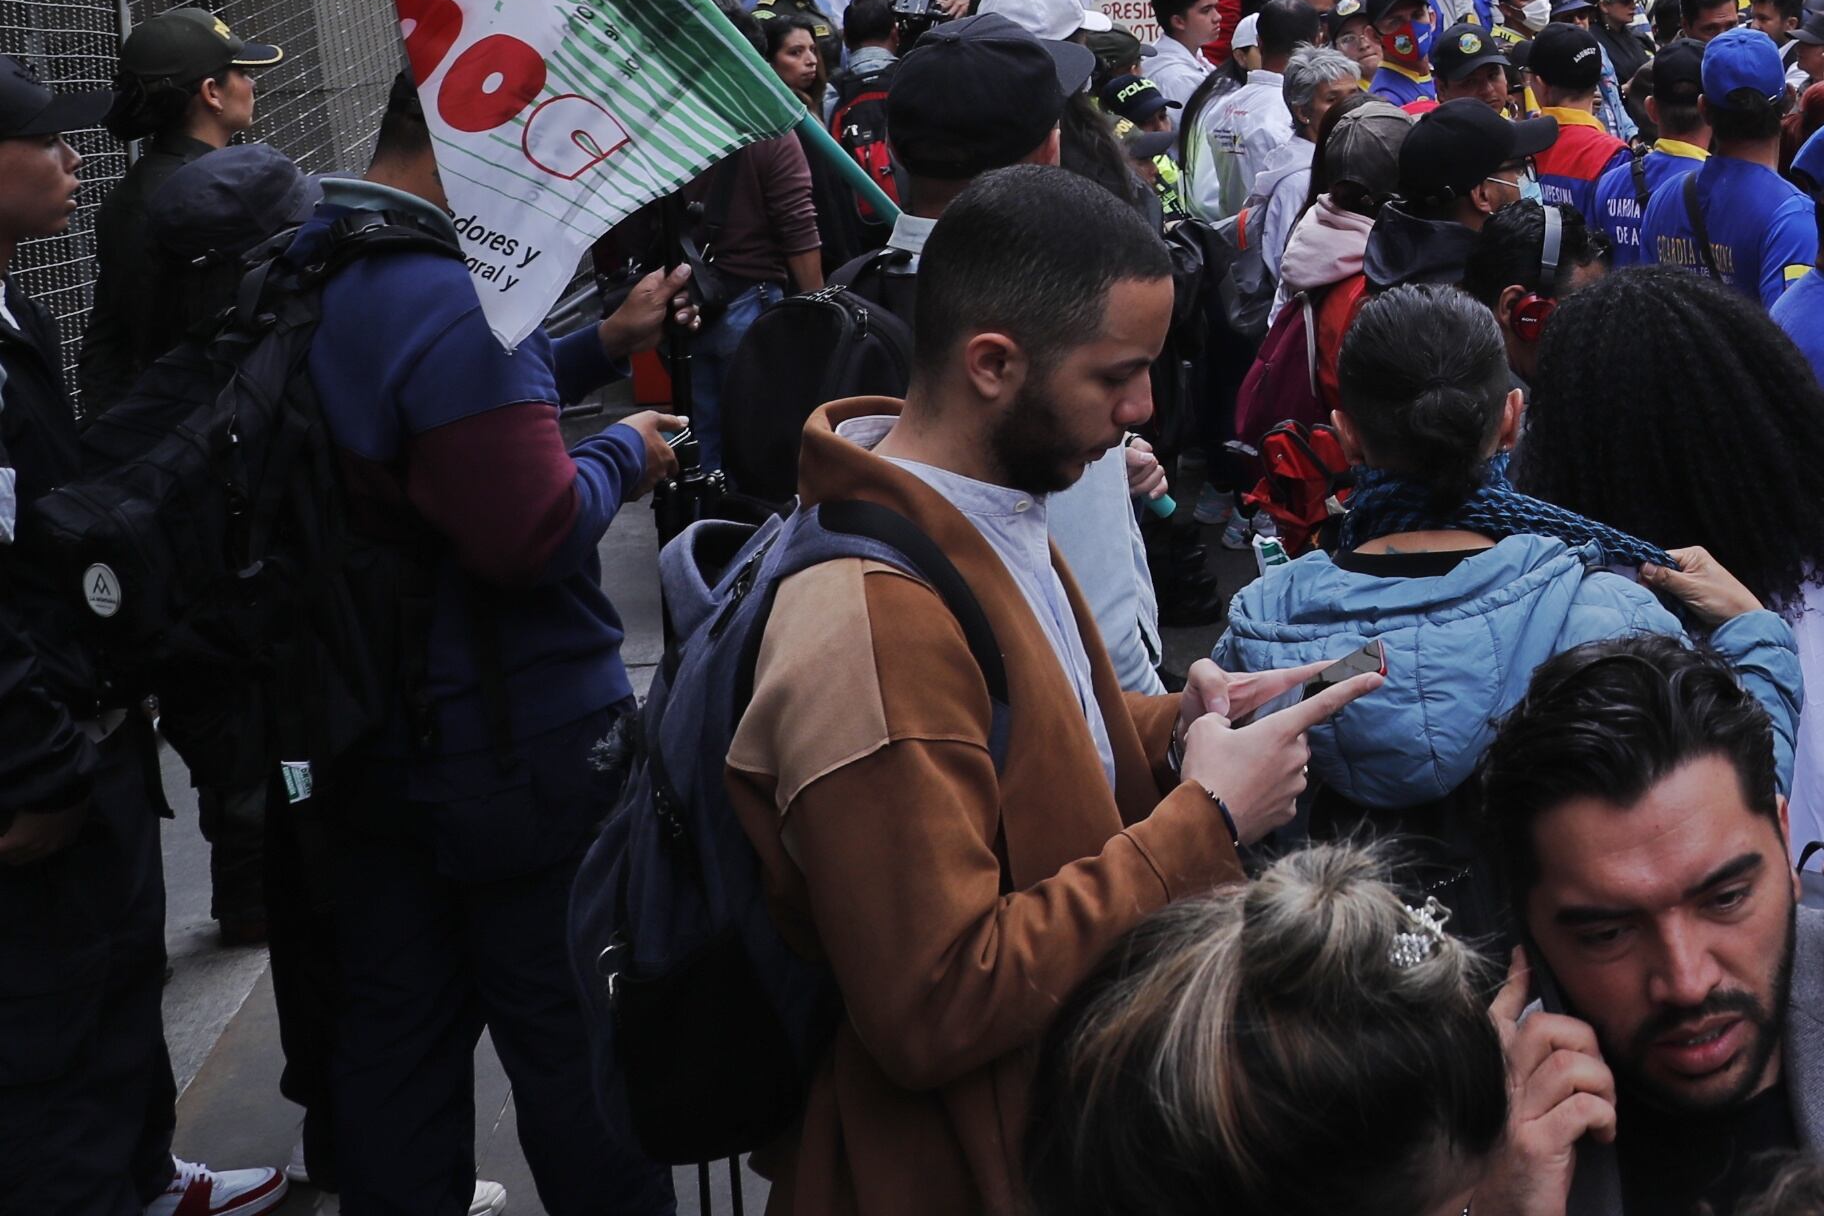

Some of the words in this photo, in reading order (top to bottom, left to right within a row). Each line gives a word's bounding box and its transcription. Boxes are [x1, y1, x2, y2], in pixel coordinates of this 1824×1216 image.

[1616, 226, 1629, 245] DE
[516, 246, 542, 269] y
[499, 275, 520, 292] y
